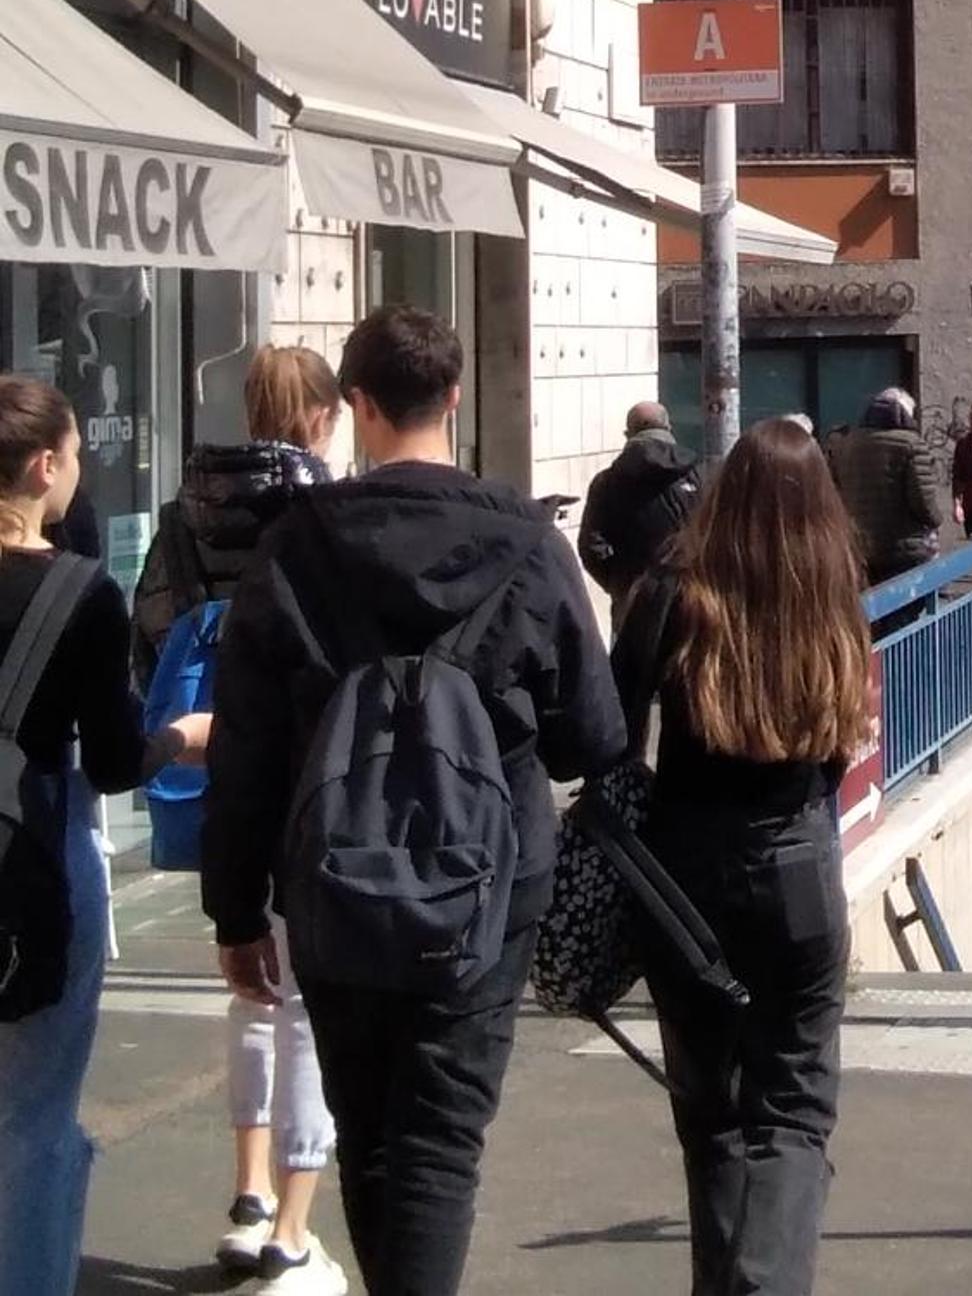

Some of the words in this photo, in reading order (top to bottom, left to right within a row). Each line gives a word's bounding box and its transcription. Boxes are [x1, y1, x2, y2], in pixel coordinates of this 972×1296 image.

[694, 12, 726, 61] A
[2, 142, 215, 257] SNACK
[371, 148, 454, 224] BAR
[87, 415, 133, 451] gima
